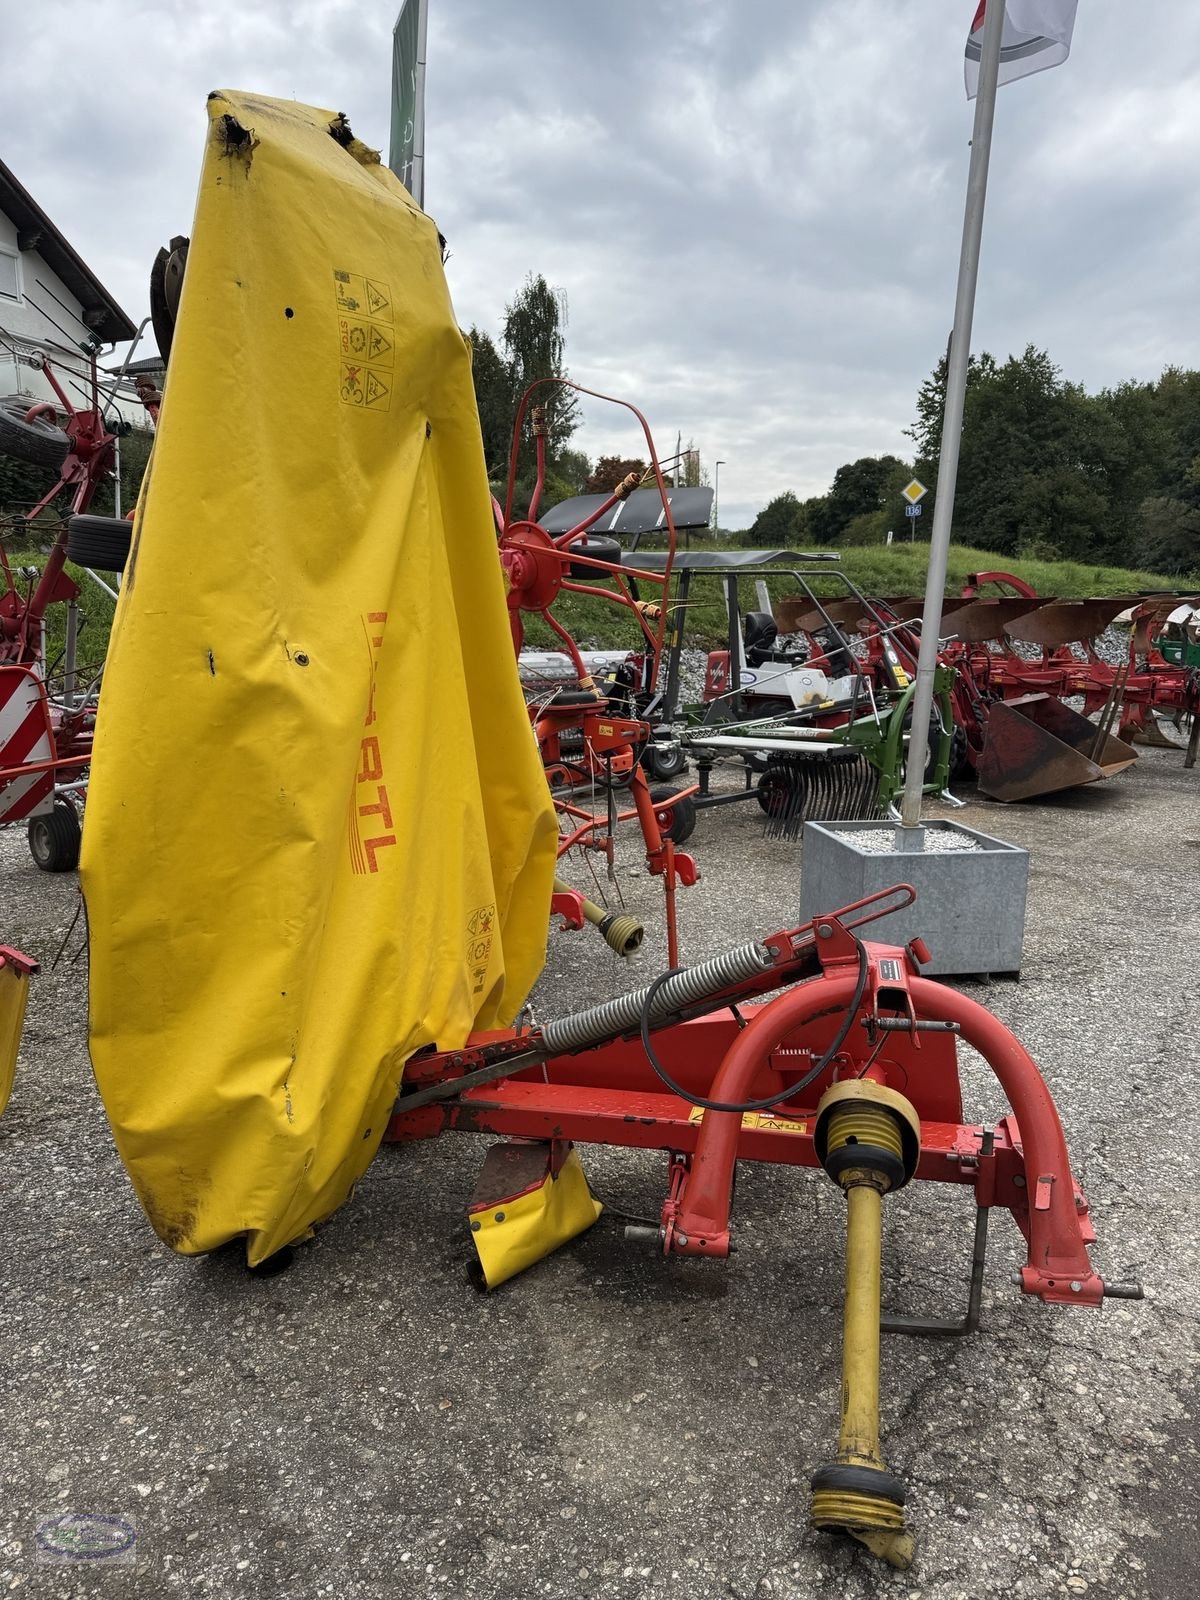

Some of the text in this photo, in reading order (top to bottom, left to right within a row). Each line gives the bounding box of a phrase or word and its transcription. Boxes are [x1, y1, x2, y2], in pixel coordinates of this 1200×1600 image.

[341, 320, 349, 353] STOP
[908, 506, 920, 515] 136
[358, 612, 397, 873] RTL
